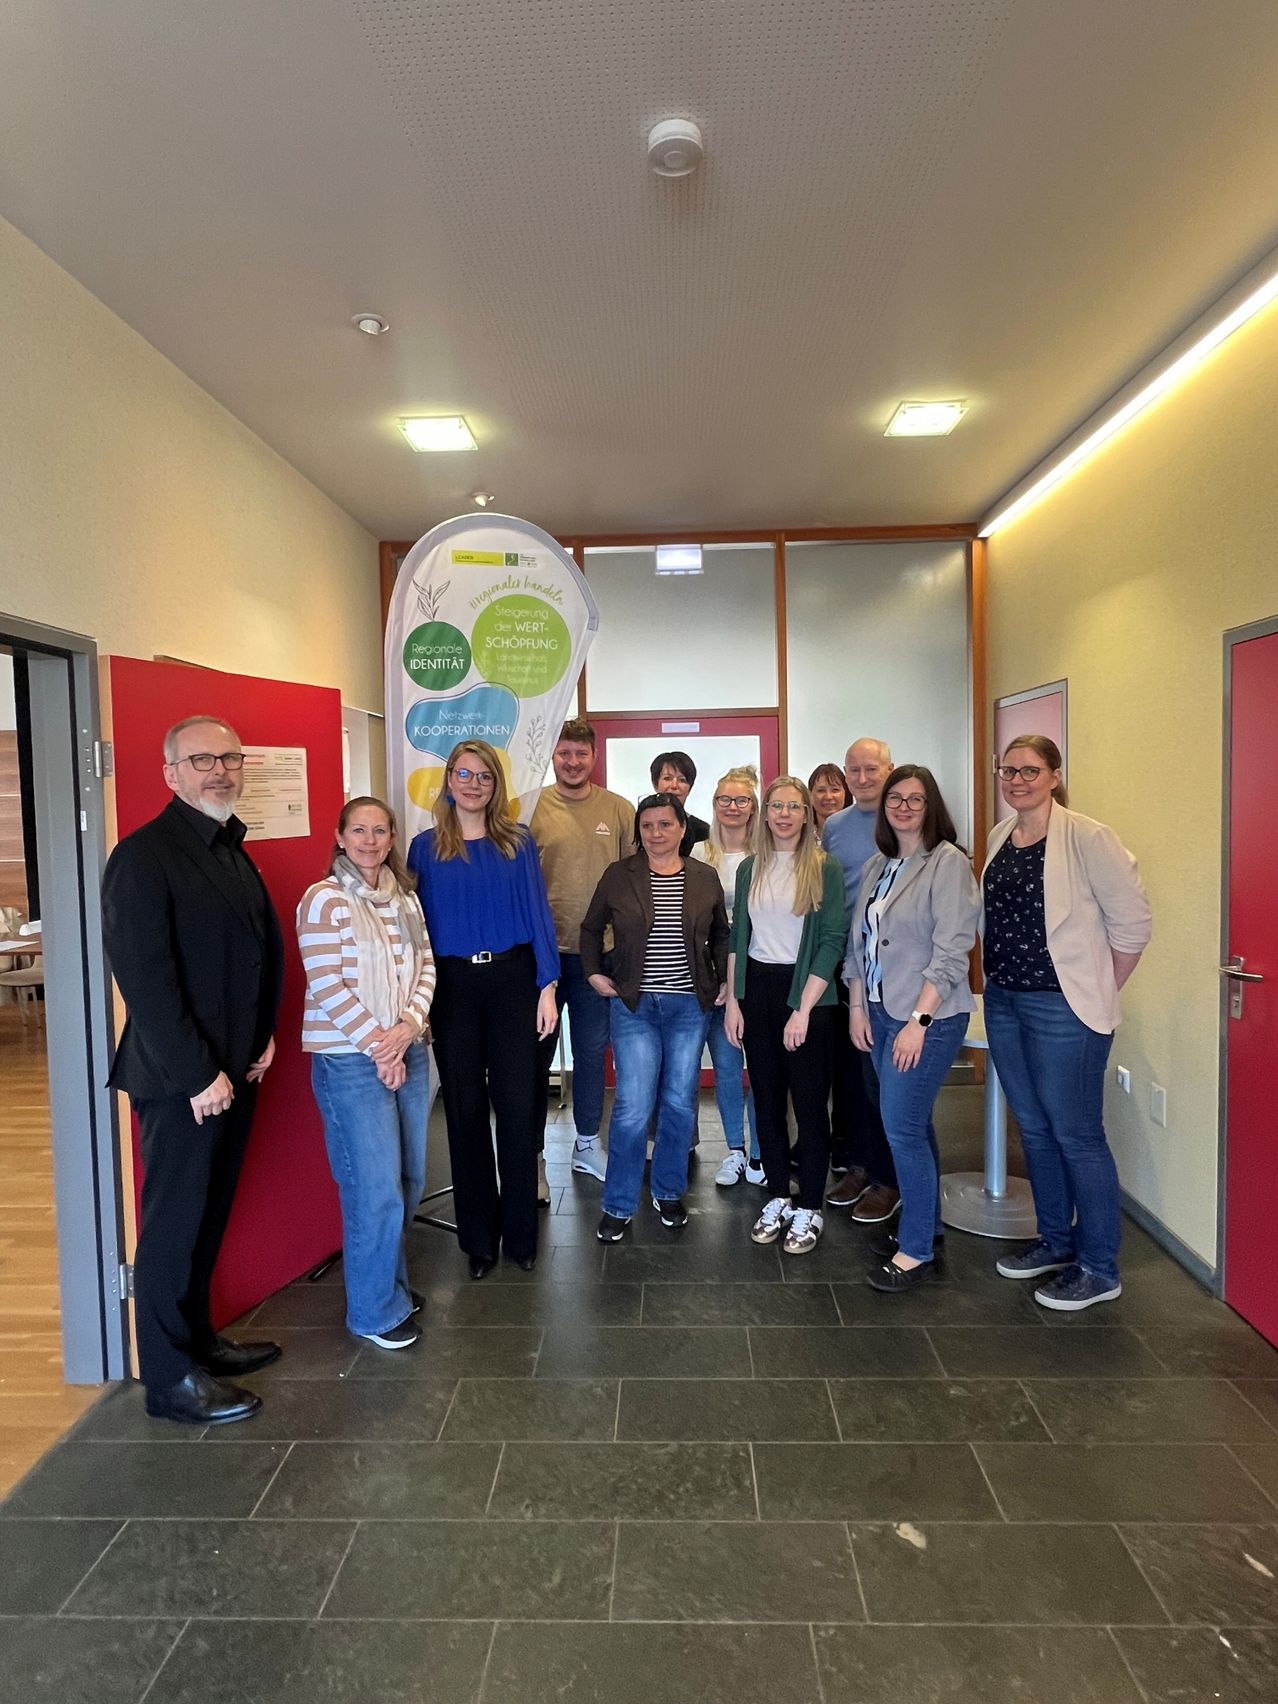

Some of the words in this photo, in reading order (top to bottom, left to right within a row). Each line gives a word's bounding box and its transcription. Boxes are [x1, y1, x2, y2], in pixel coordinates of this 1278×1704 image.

[495, 605, 549, 620] Steigerung
[514, 621, 549, 633] WERT-
[411, 642, 463, 656] Regionale
[485, 635, 558, 650] SCHÖPFUNG
[410, 656, 465, 670] IDENTITÄT
[414, 725, 510, 737] KOOPERATIONEN
